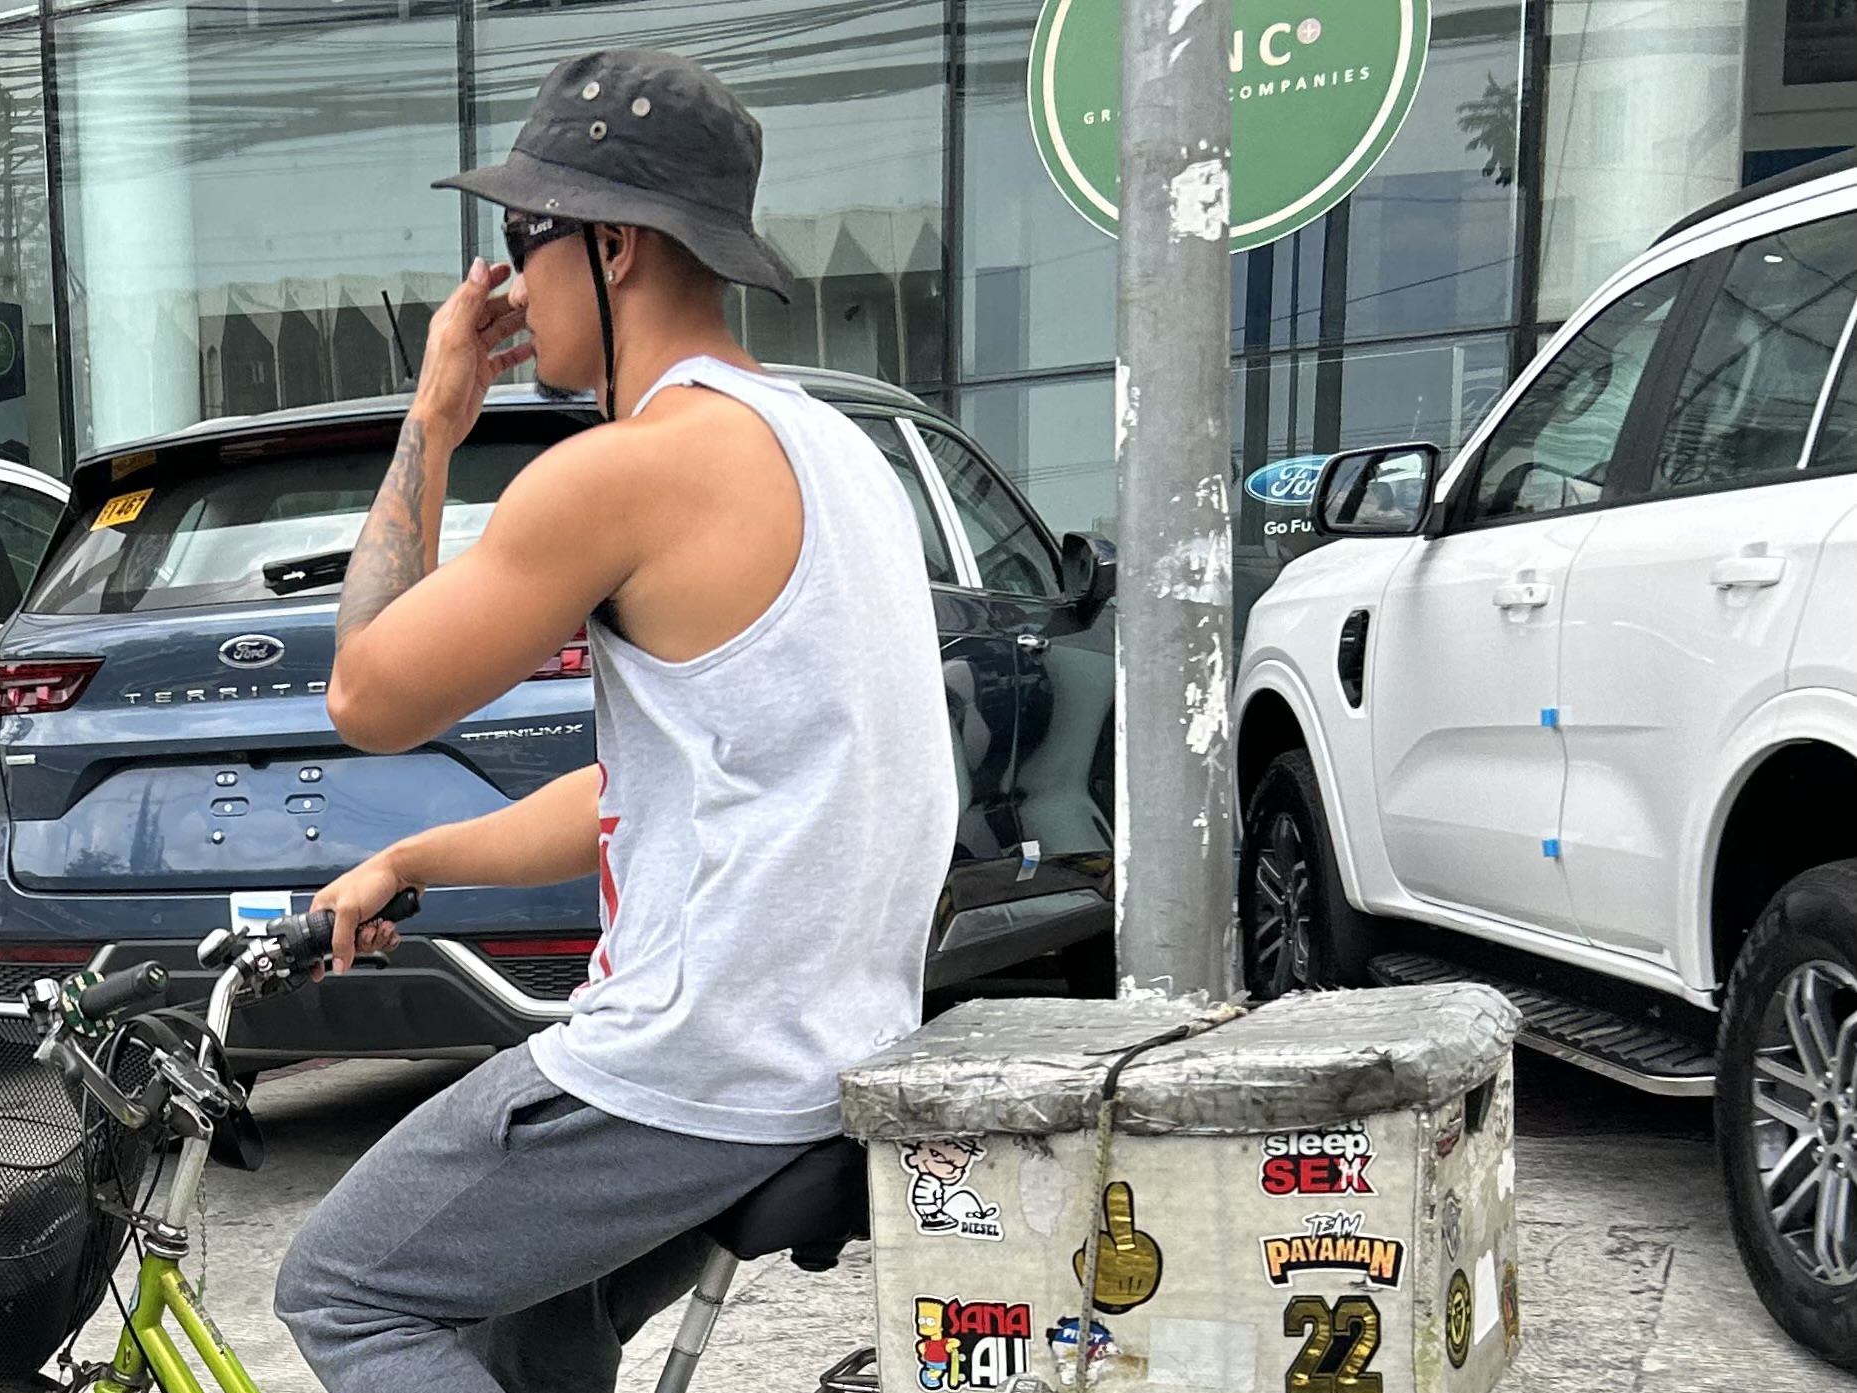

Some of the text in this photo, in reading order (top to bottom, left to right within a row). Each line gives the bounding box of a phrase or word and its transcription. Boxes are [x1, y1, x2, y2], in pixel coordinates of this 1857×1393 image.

[1083, 109, 1121, 125] GR
[1263, 519, 1315, 535] Go Fu
[233, 640, 270, 660] Ford
[1266, 1132, 1369, 1161] sleep
[1264, 1158, 1370, 1192] SEX
[961, 1221, 999, 1236] DIESEL
[1304, 1212, 1363, 1240] TEAM
[1265, 1236, 1399, 1280] PAYAMAN
[947, 1301, 1029, 1337] SANA
